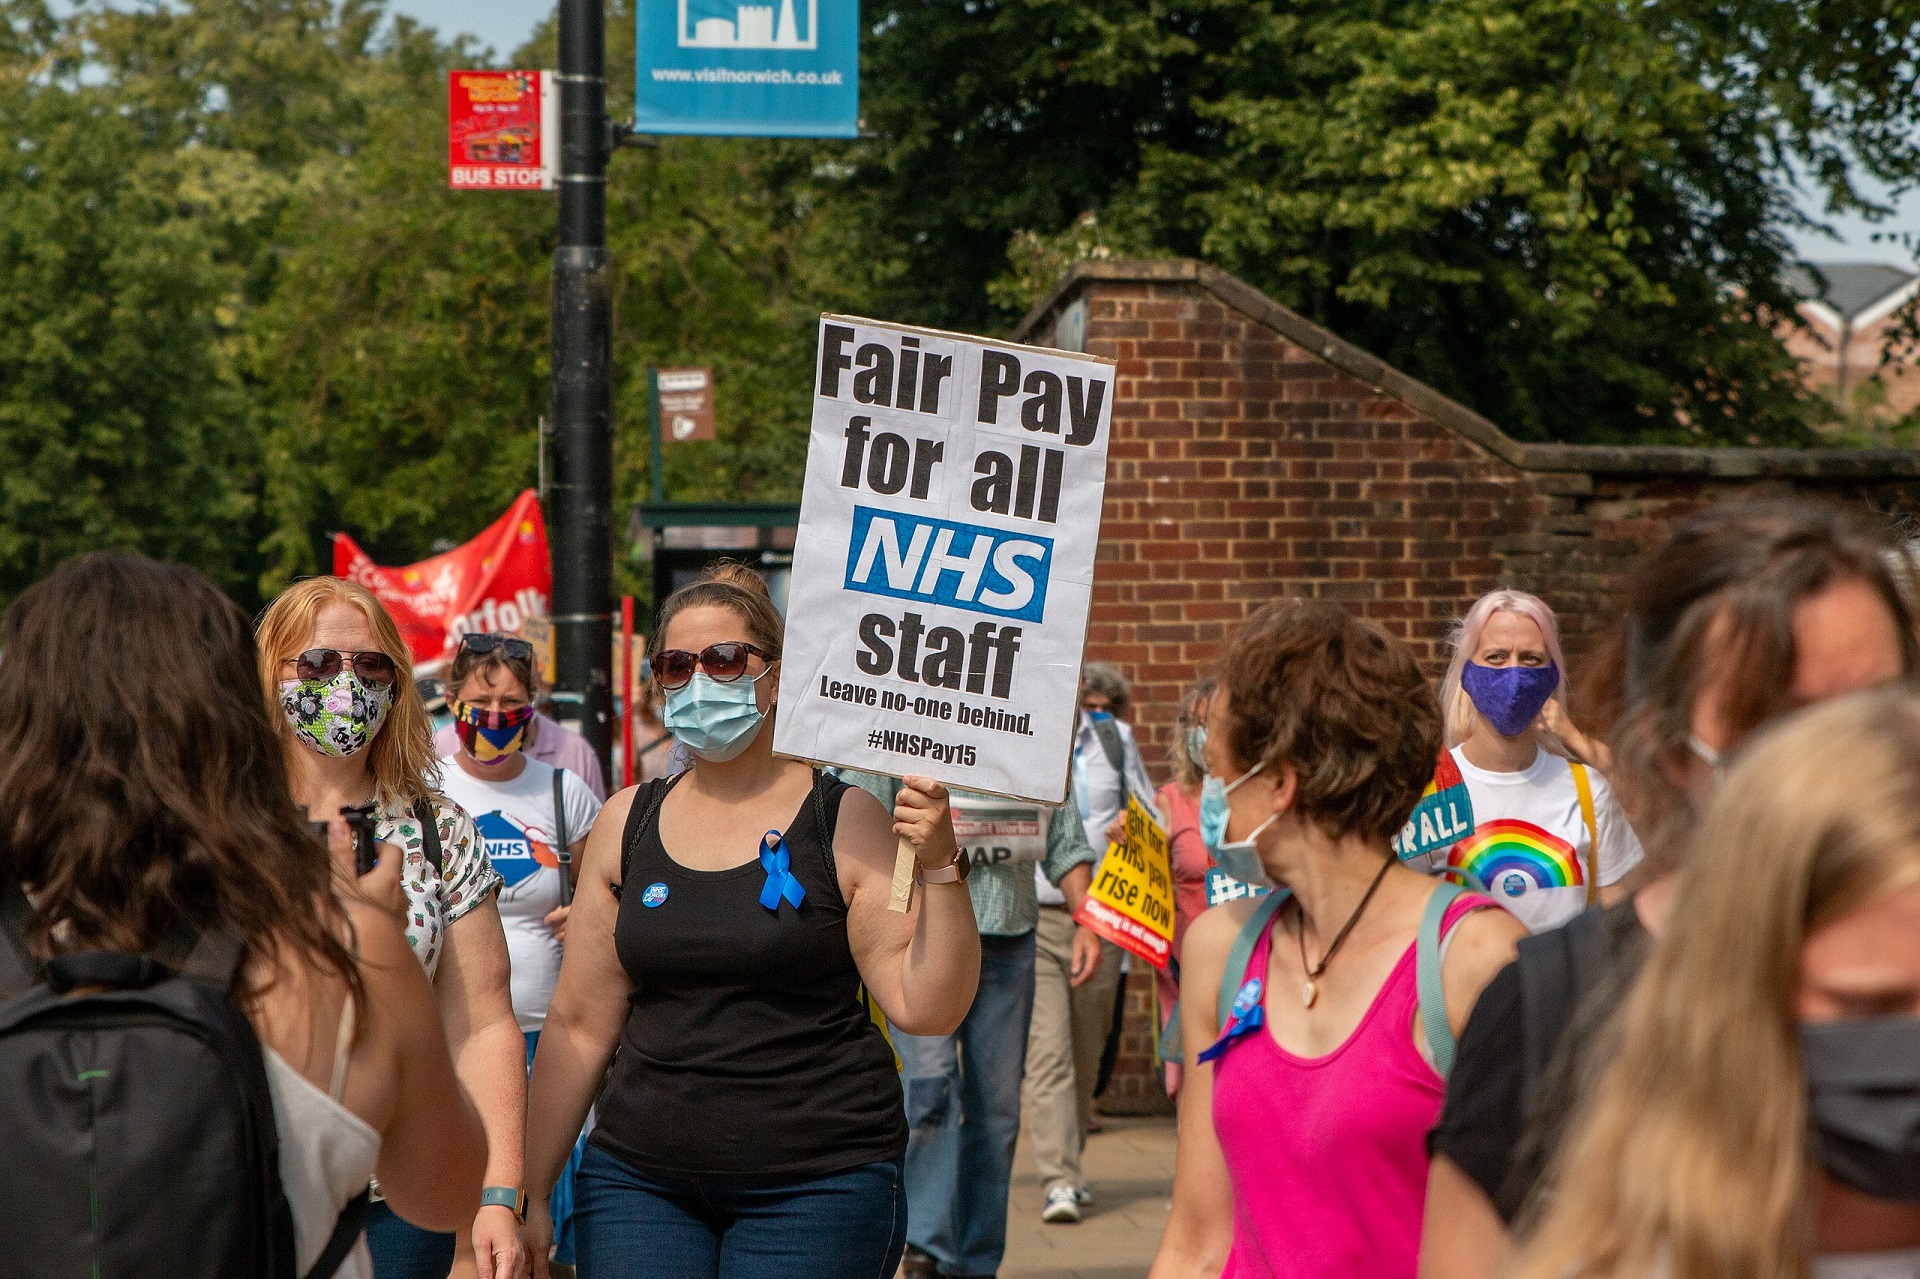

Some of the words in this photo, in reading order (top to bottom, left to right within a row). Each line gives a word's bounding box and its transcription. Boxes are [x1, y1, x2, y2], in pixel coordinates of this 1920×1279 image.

[651, 67, 842, 85] www.visitnorwich.co.uk
[452, 167, 491, 184] BUS
[494, 167, 543, 185] STOP
[819, 324, 952, 415] Fair
[977, 349, 1107, 447] Pay
[840, 415, 944, 499] for
[970, 445, 1064, 524] all
[851, 516, 1046, 611] NHS
[855, 611, 1023, 700] staff
[819, 675, 878, 710] Leave
[881, 691, 952, 721] no-one
[957, 702, 1034, 736] behind.
[867, 729, 977, 767] #NHSPay15
[484, 842, 524, 856] NHS
[971, 846, 1012, 866] AP
[1097, 867, 1139, 907] rise
[1140, 892, 1171, 930] now
